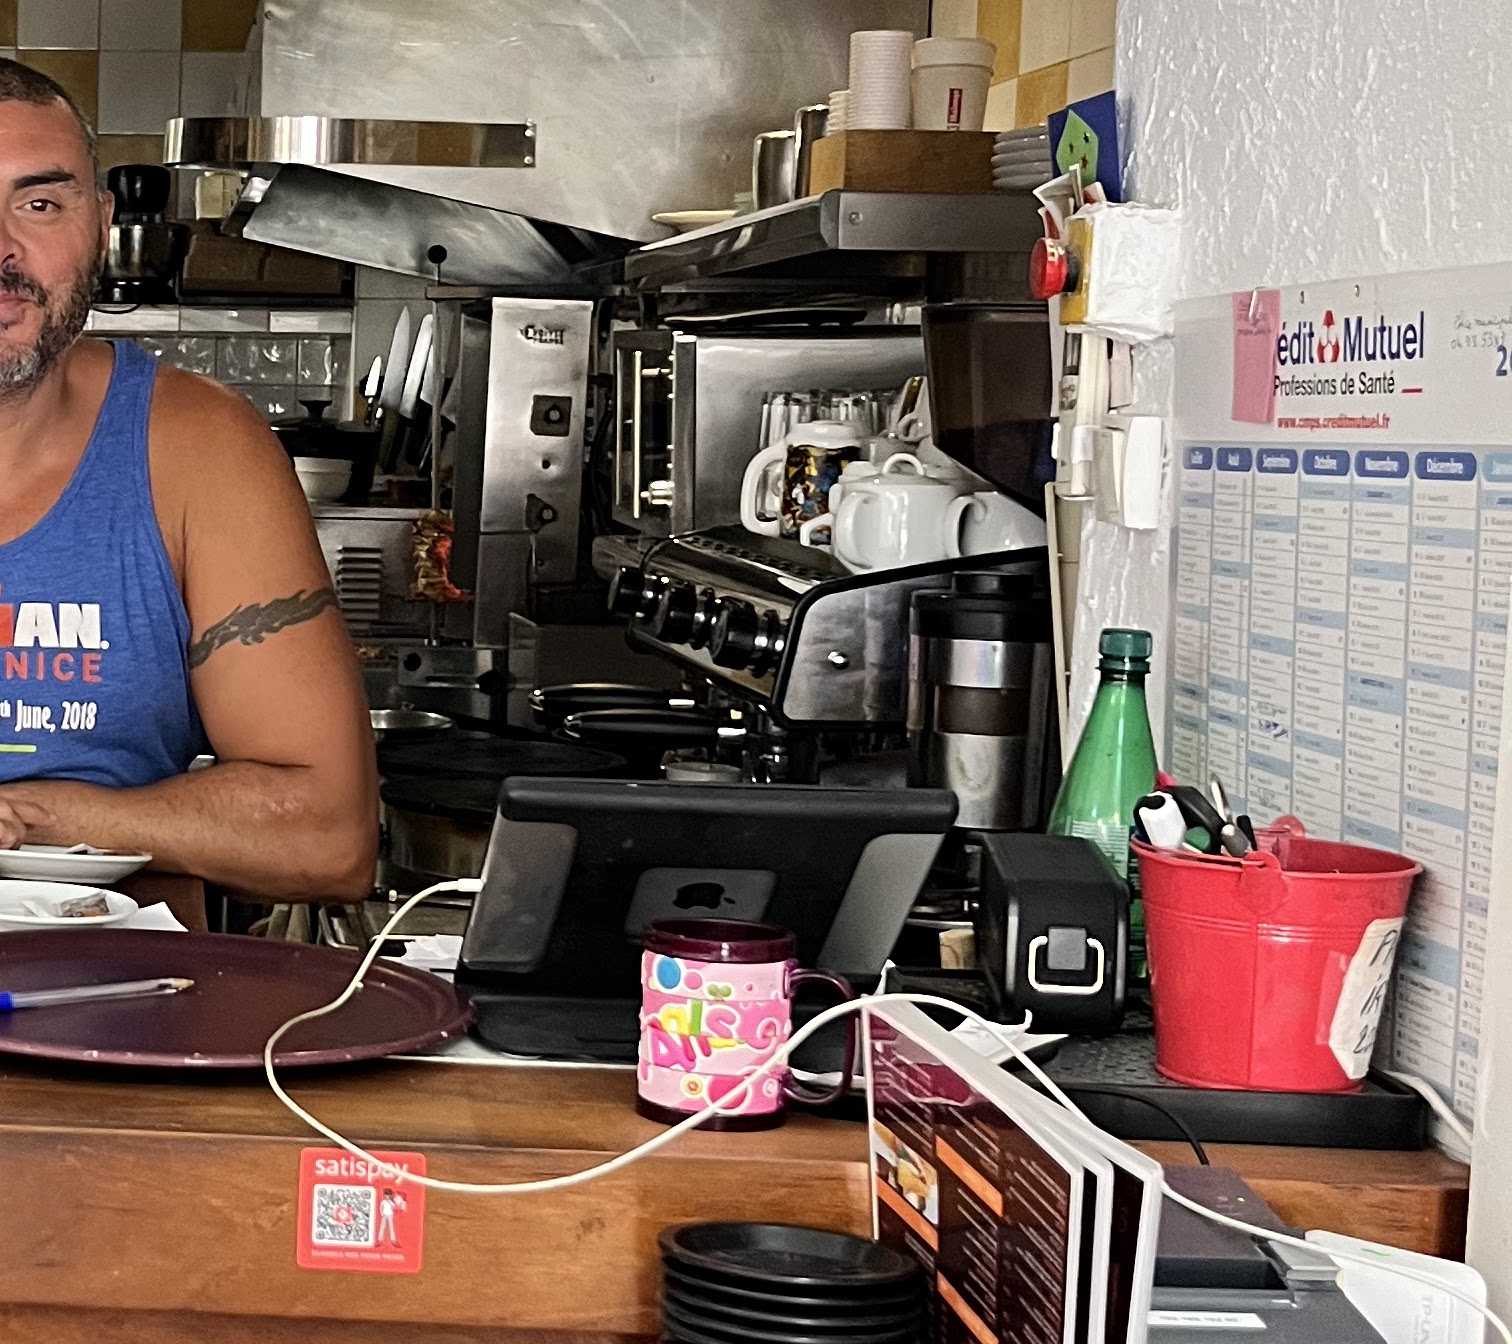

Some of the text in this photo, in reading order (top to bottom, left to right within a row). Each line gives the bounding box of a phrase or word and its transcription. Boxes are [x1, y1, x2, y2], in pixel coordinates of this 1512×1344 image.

[1276, 321, 1315, 366] édit
[1342, 310, 1425, 364] Mutuel
[1273, 369, 1395, 397] Professions de Santé
[4, 651, 104, 684] NICE
[14, 702, 56, 733] June,
[61, 701, 98, 731] 2018
[314, 1156, 409, 1186] satispay
